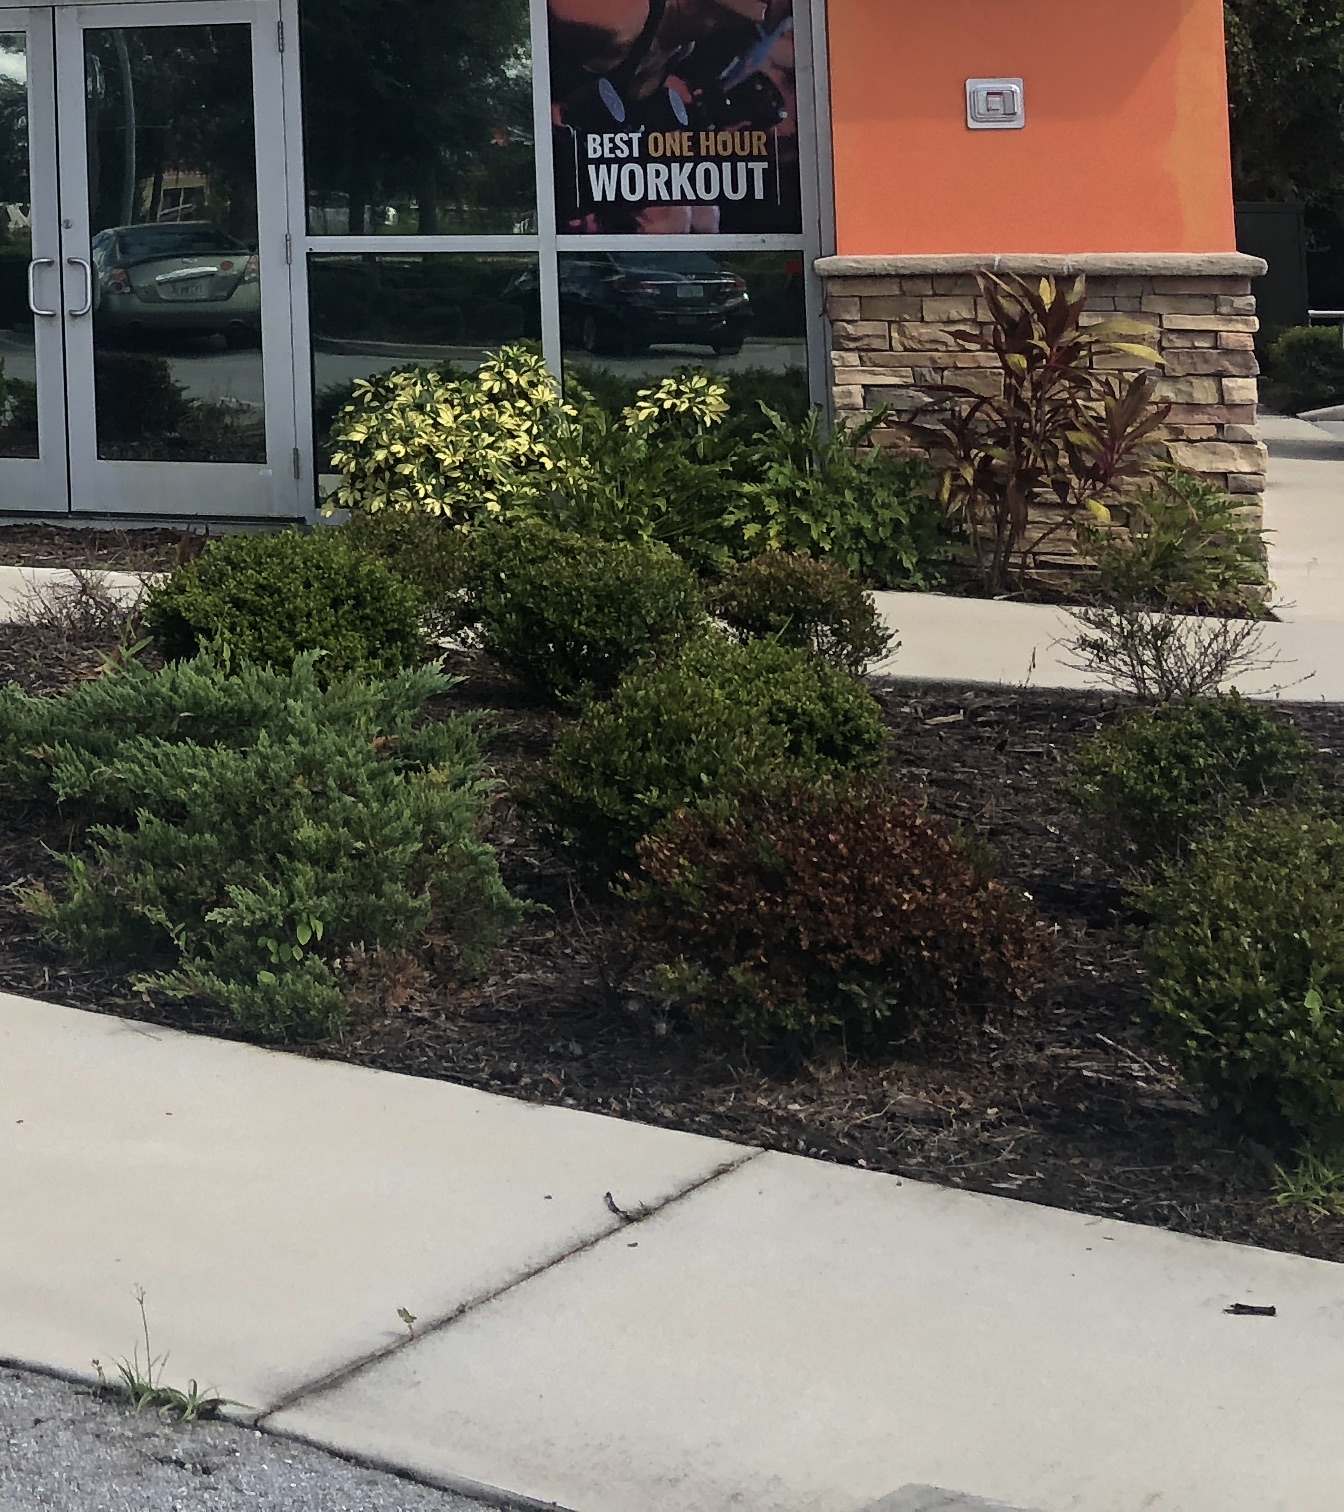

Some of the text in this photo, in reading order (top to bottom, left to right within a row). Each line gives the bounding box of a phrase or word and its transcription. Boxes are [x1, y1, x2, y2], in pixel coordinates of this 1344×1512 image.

[587, 130, 768, 159] BEST ONE HOUR
[587, 161, 769, 202] WORKOUT
